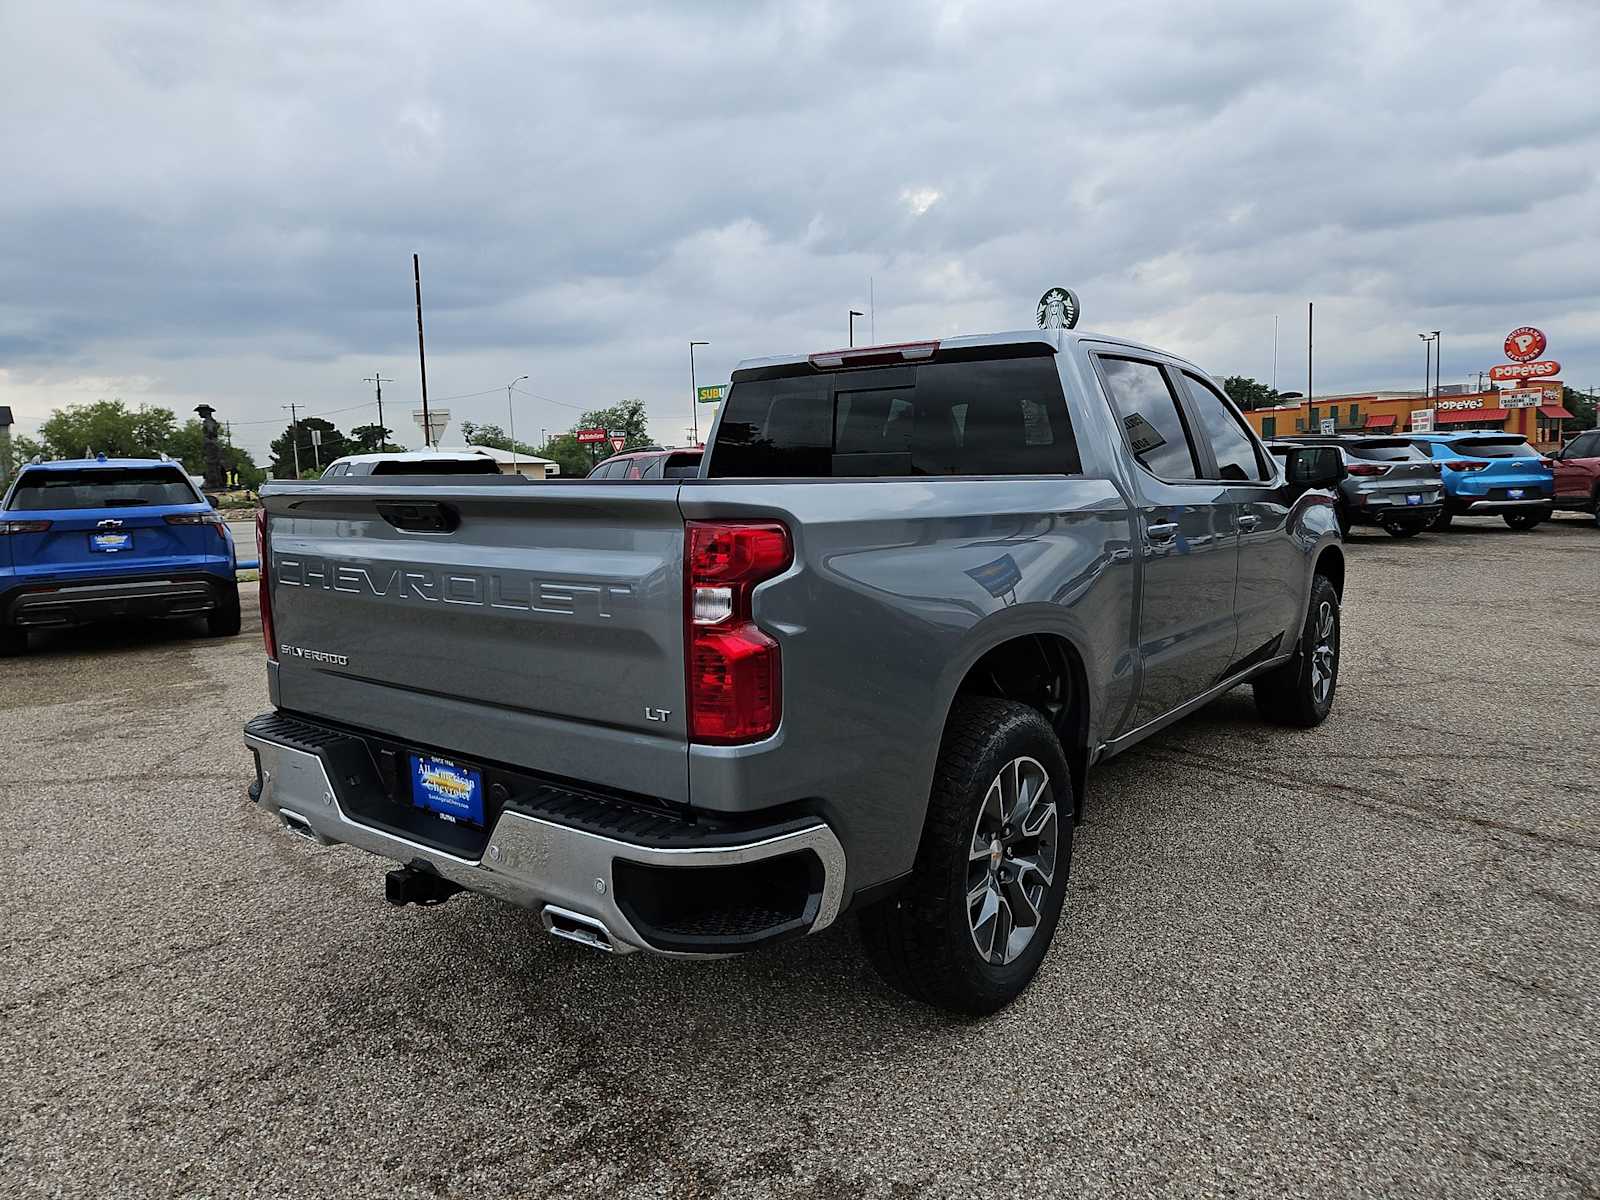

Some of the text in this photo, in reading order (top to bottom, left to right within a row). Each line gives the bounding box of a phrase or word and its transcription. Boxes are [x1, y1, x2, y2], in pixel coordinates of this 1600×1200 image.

[1506, 328, 1541, 344] LOUISIANA
[1514, 334, 1534, 352] P
[1506, 348, 1540, 361] KITCHEN
[277, 558, 634, 619] CHEVROLET
[280, 644, 349, 666] SILVERADO
[645, 706, 672, 722] LT
[418, 763, 476, 790] All American
[425, 780, 471, 801] Chevrolet
